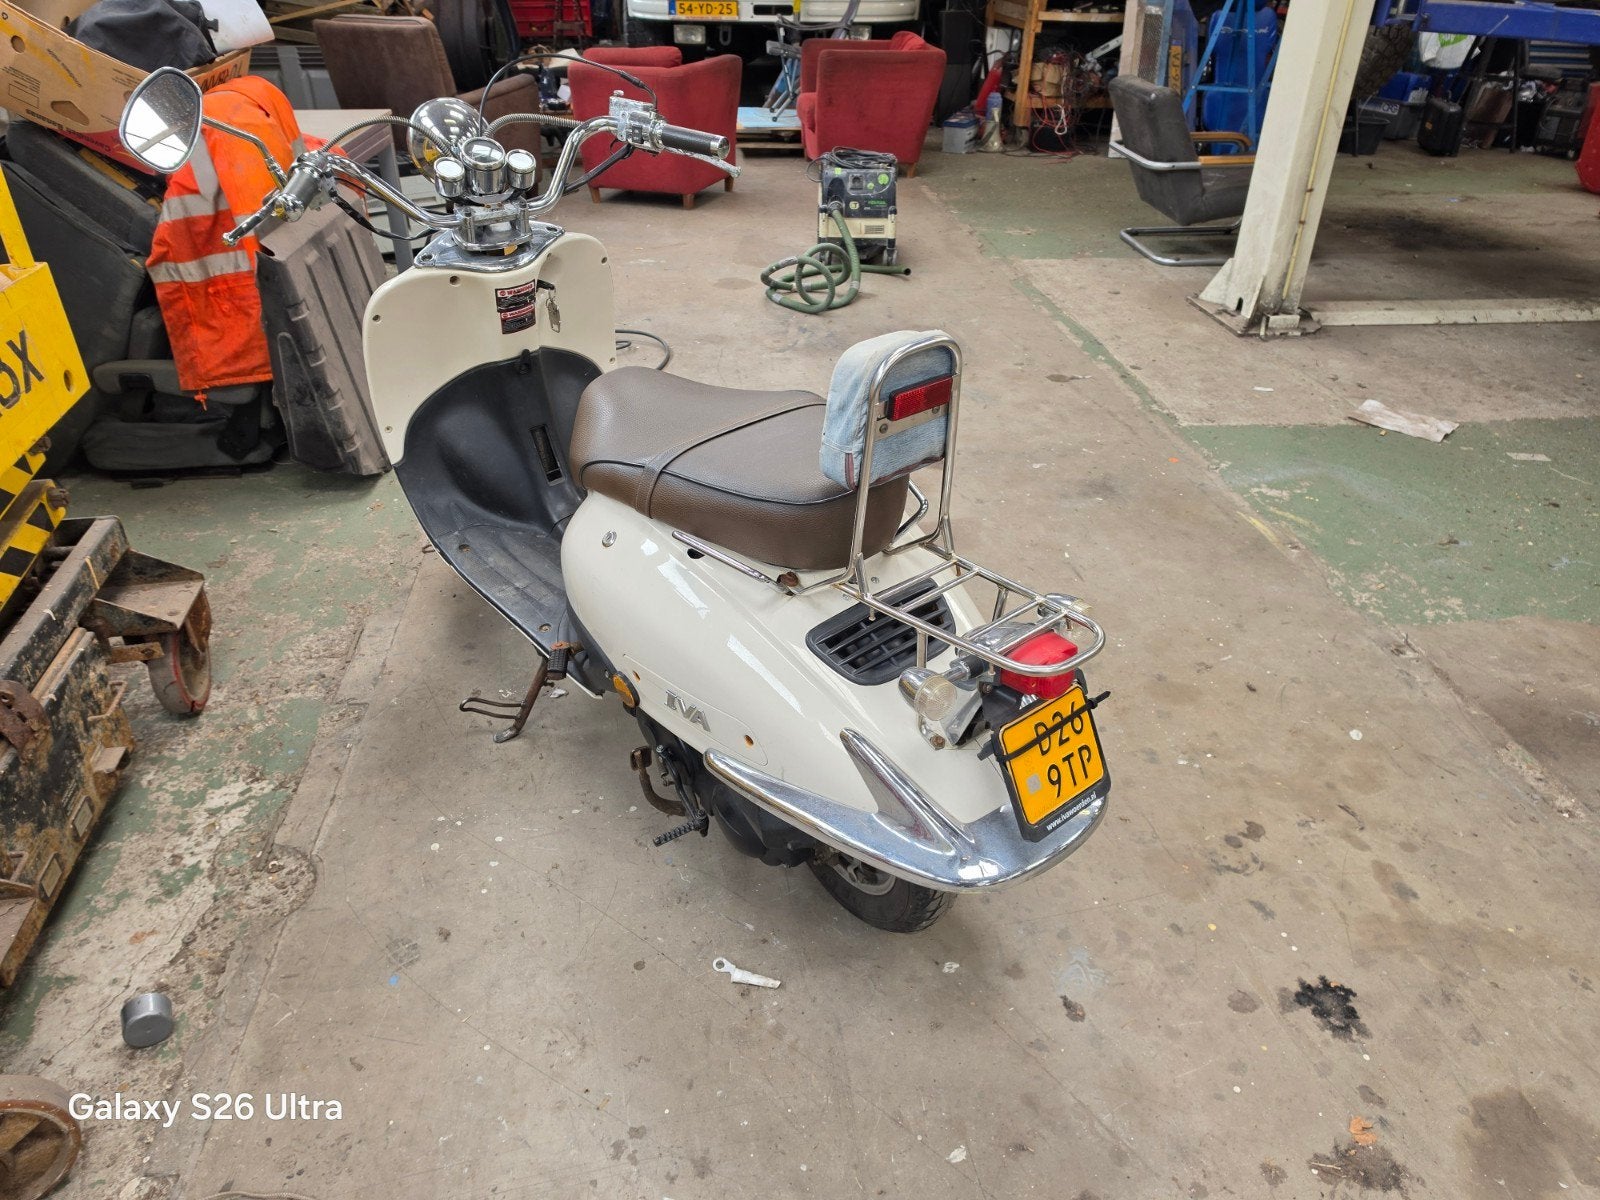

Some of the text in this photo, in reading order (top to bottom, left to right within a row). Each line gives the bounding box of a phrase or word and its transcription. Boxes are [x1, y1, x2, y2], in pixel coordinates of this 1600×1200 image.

[679, 3, 733, 15] 54-YD-25
[664, 689, 712, 733] IVA
[1047, 744, 1092, 798] 9TP
